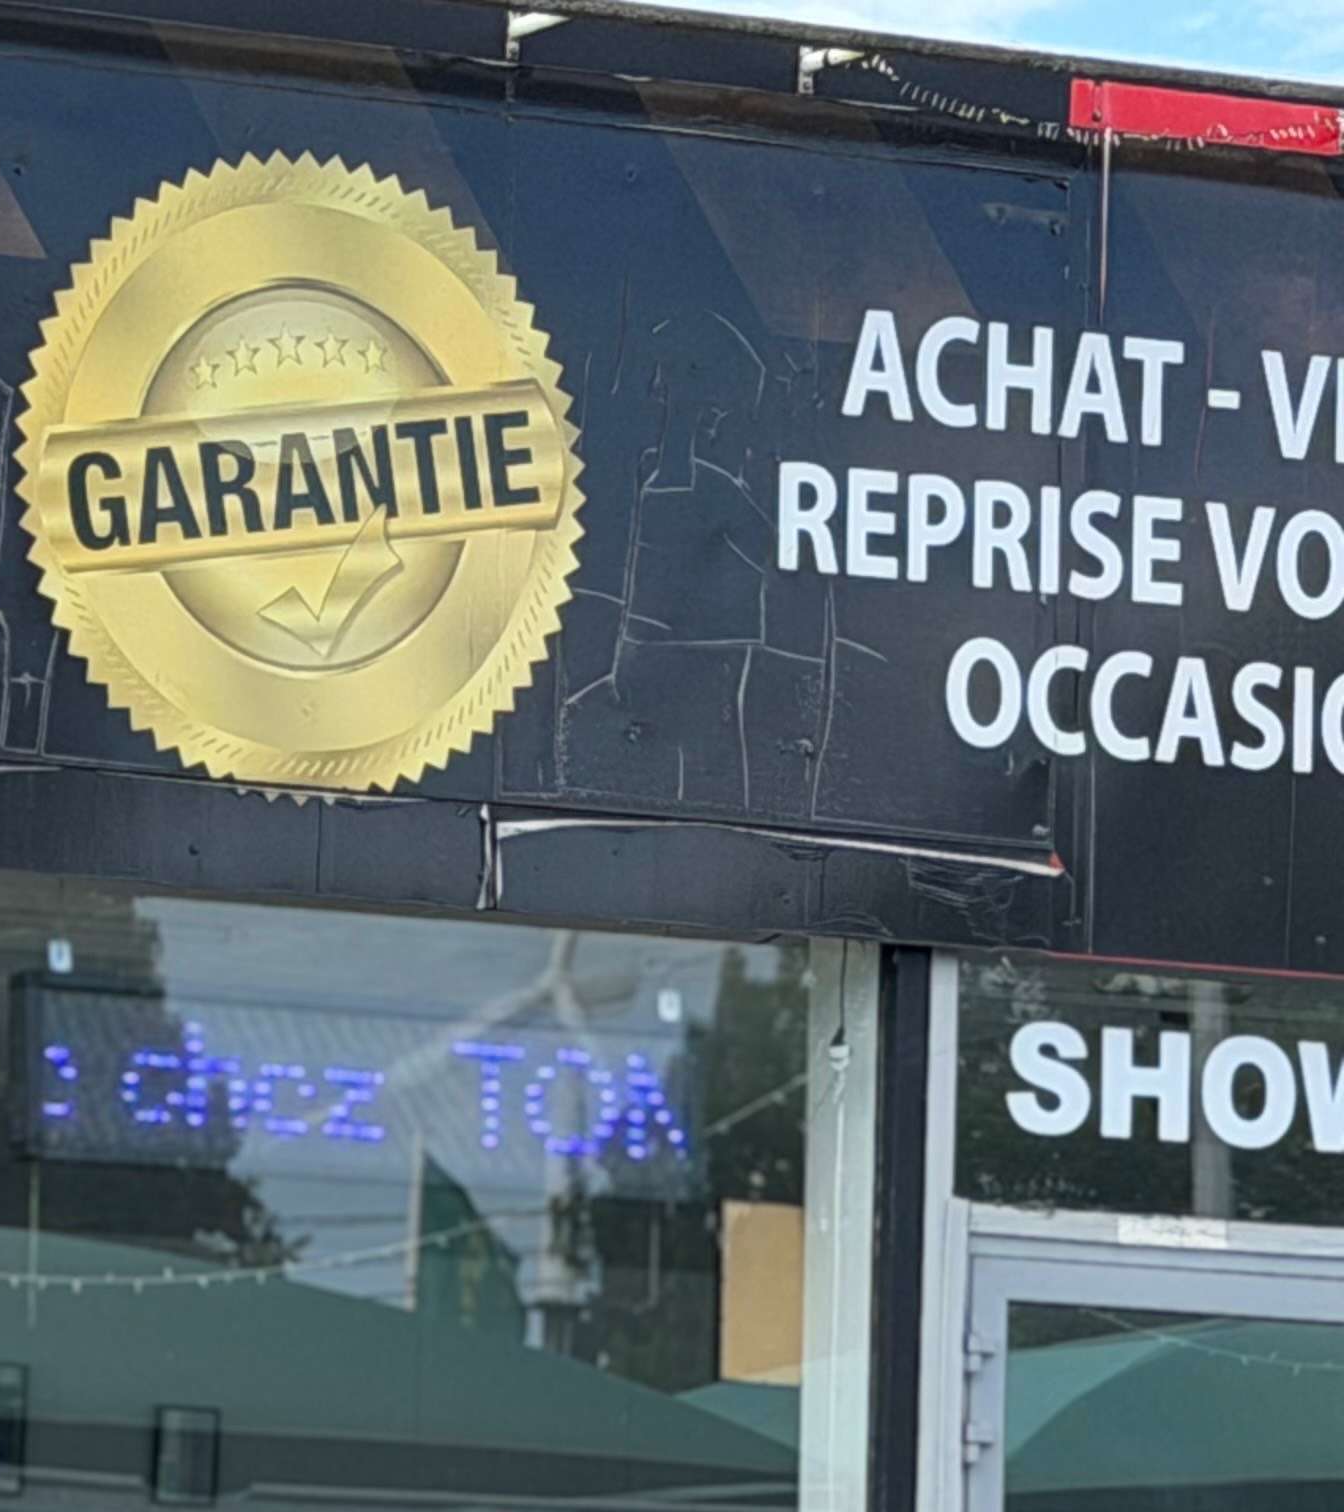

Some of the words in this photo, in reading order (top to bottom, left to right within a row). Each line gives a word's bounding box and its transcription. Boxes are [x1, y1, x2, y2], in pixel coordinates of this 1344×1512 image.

[841, 309, 1185, 446] ACHAT
[1261, 350, 1344, 464] V
[65, 410, 542, 551] GARANTIE
[777, 461, 1184, 606] REPRISE
